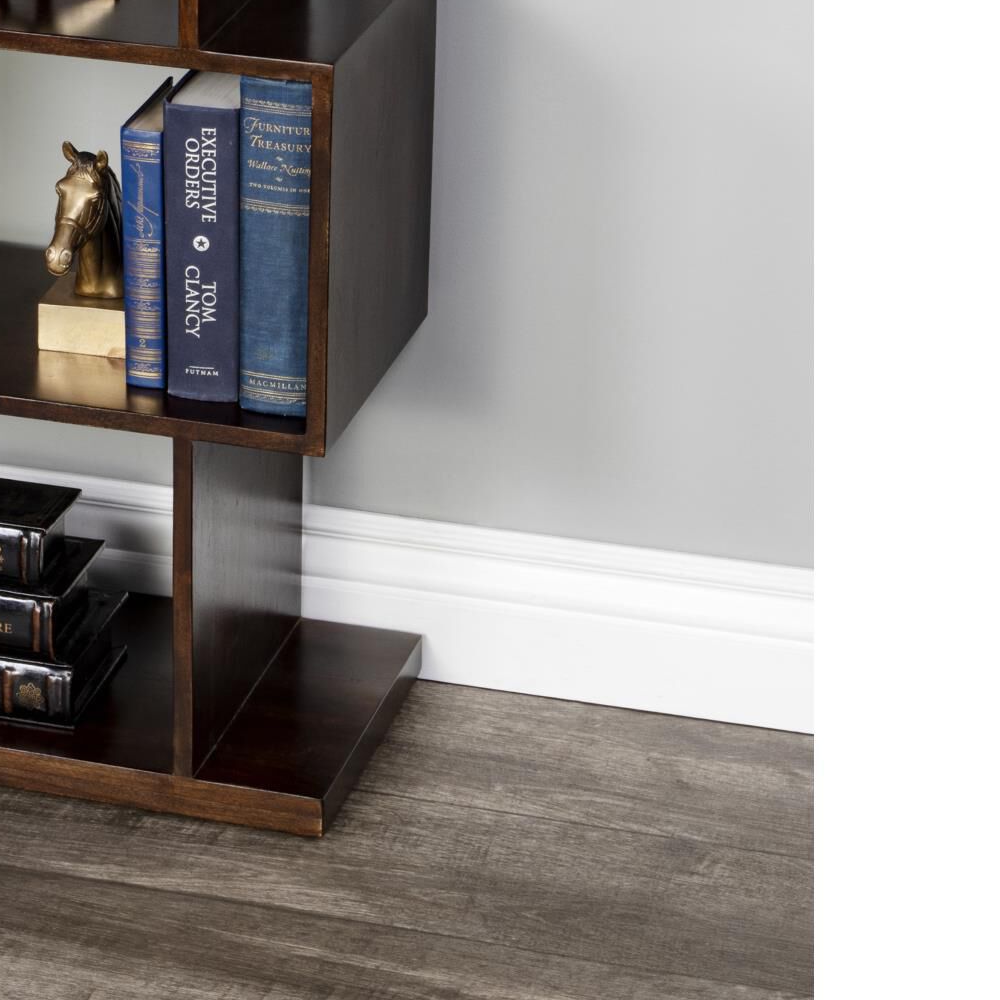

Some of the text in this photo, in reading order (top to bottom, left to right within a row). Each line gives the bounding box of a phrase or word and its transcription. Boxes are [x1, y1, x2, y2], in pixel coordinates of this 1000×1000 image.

[243, 116, 311, 136] FURNITUR
[249, 135, 312, 153] TREASURY
[185, 137, 200, 210] ORDERS
[201, 127, 217, 223] EXECUTIVE
[247, 159, 278, 172] Wallace
[185, 264, 200, 338] CLANCY
[201, 282, 217, 323] TOM
[138, 338, 147, 347] 2
[185, 368, 219, 377] PUTNAM
[248, 377, 306, 391] MACMILLAN
